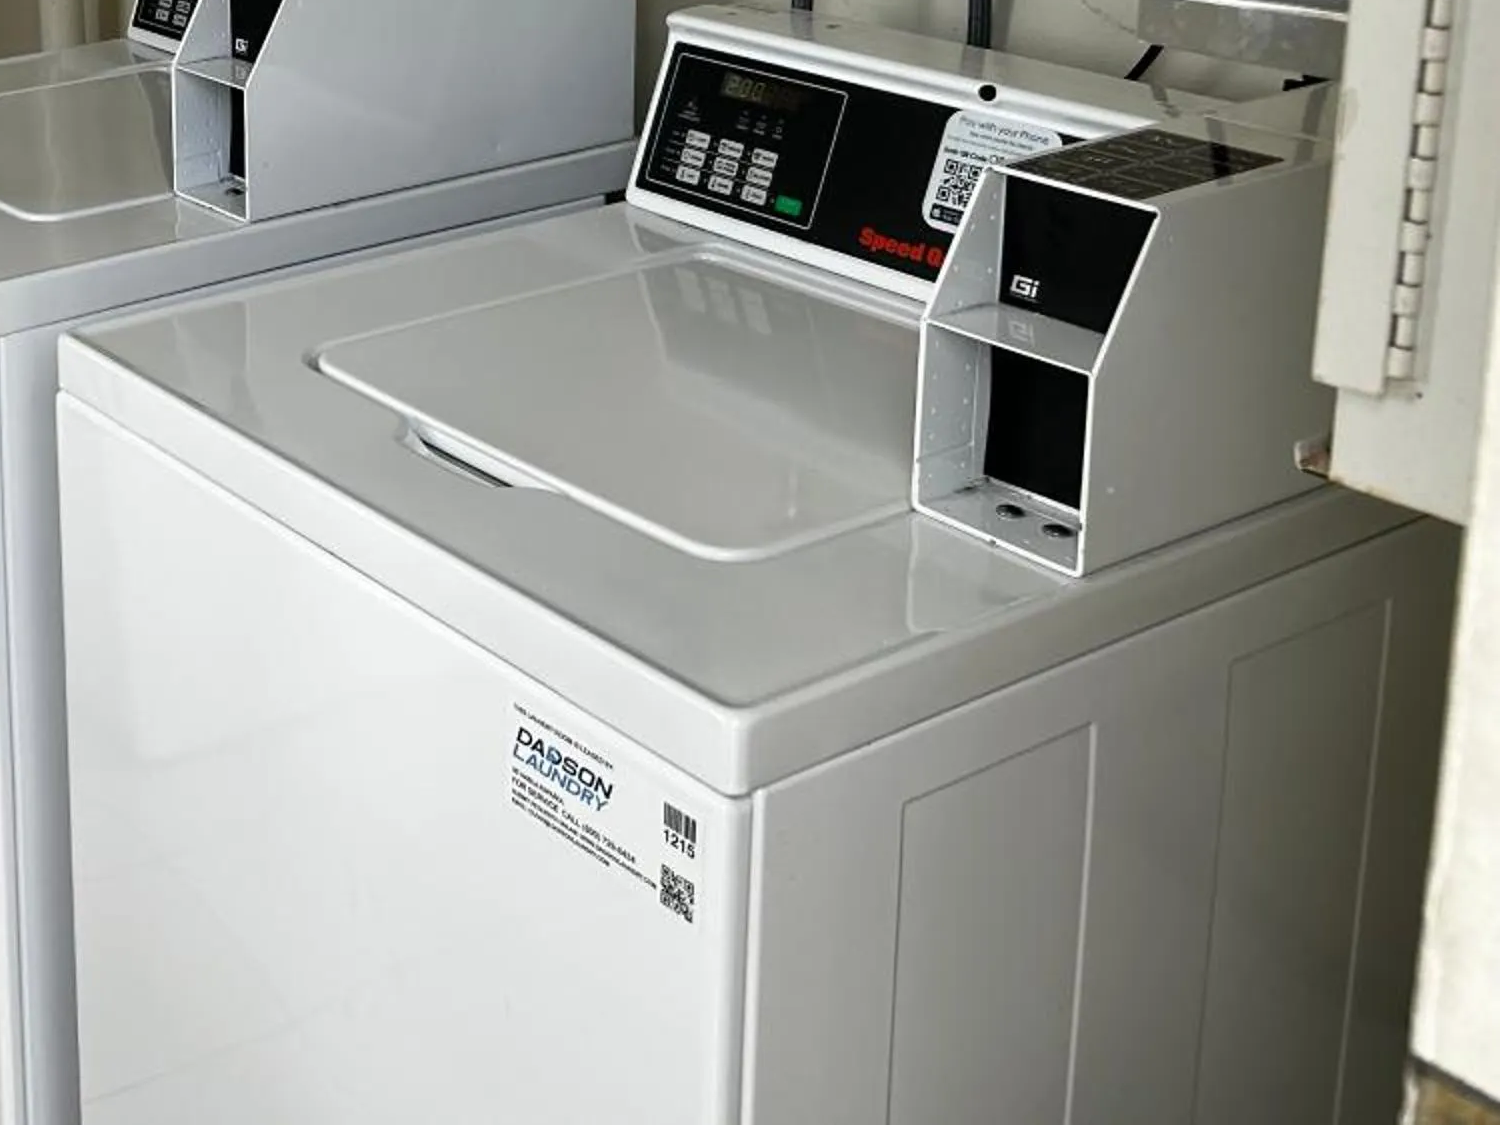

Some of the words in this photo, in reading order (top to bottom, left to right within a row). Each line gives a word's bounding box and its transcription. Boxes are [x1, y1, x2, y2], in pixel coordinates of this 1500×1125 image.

[978, 121, 997, 133] with
[999, 126, 1018, 138] your
[1019, 130, 1050, 146] Phone
[858, 225, 925, 262] Speed
[1011, 274, 1040, 298] Gi
[513, 743, 609, 812] LAUNDRY
[516, 726, 613, 800] DADSON
[663, 829, 696, 859] 1215
